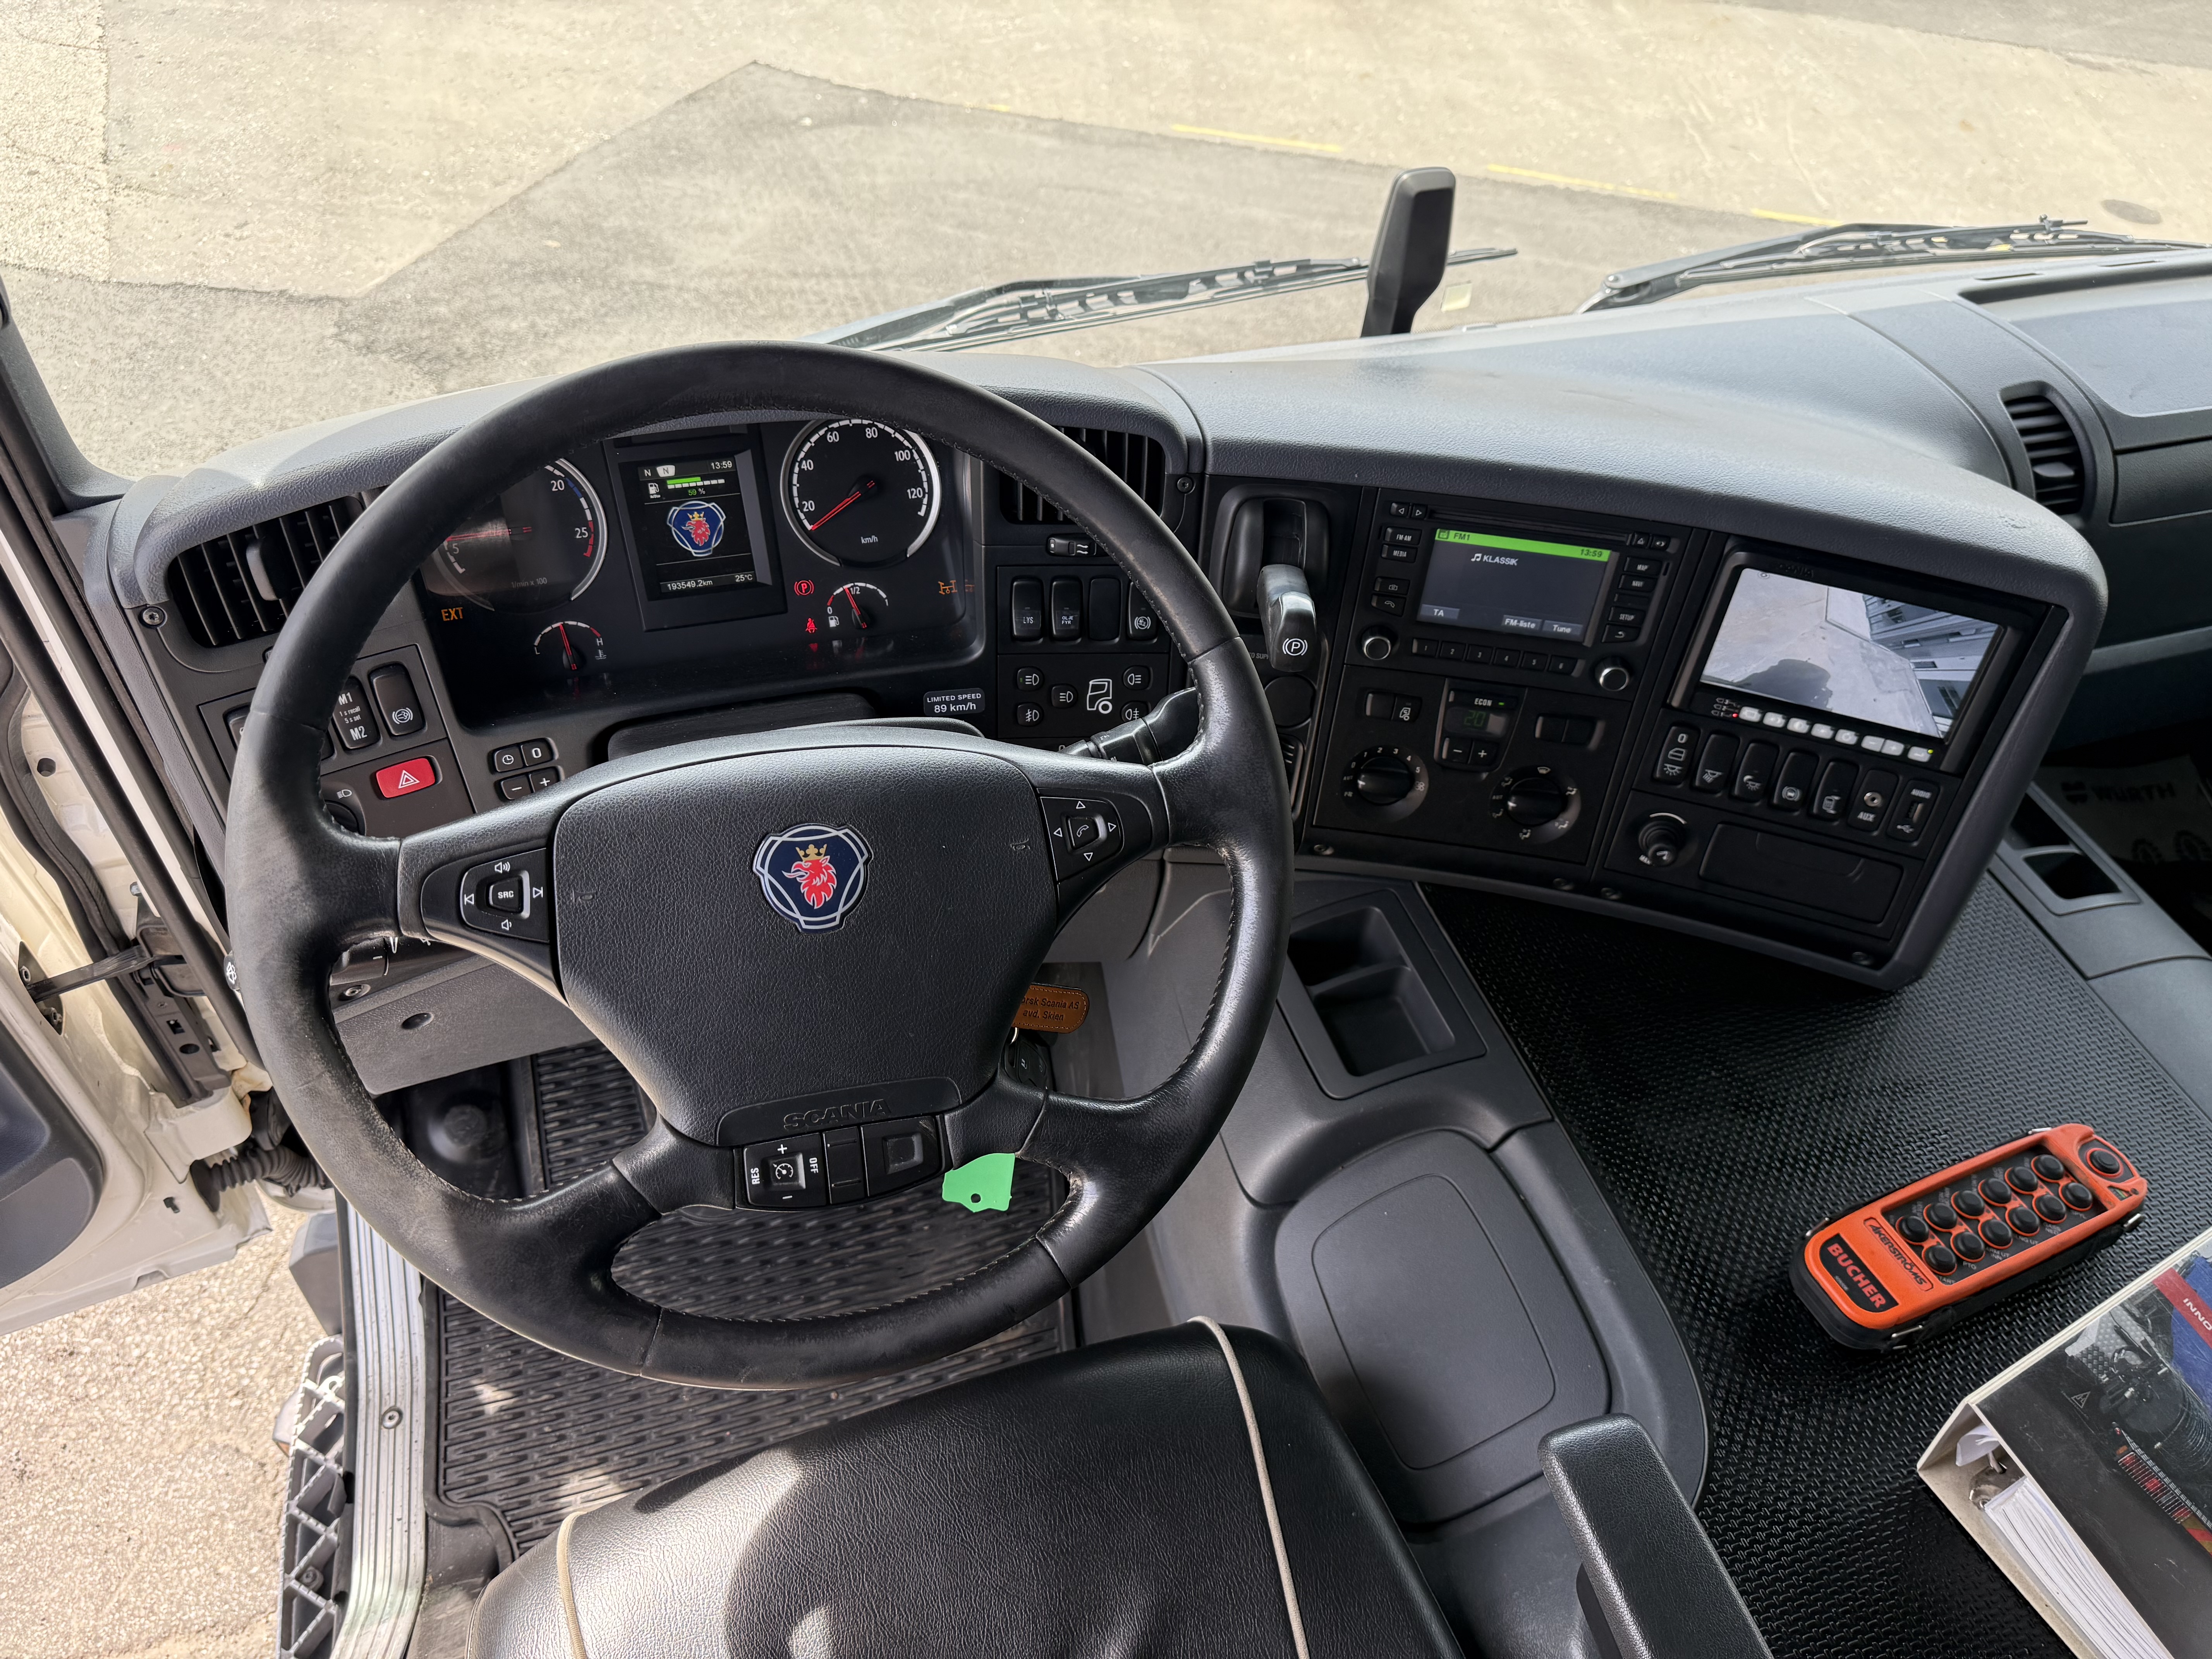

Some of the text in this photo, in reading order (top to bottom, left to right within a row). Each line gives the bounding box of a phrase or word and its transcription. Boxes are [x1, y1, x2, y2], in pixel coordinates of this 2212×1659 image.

[827, 431, 839, 442] 60
[866, 428, 878, 438] 80
[894, 450, 910, 461] 100
[711, 460, 732, 470] 13:59
[801, 460, 814, 471] 40
[551, 480, 565, 491] 20
[907, 488, 923, 499] 120
[802, 501, 815, 512] 20
[575, 527, 588, 538] 25
[1453, 532, 1470, 541] FM1
[861, 535, 878, 544] km/h
[452, 543, 459, 554] 5
[1580, 548, 1602, 558] 13:59
[1483, 555, 1518, 567] KLASSIK
[511, 580, 529, 589] 1/min
[536, 577, 547, 586] 100
[667, 574, 753, 591] 193549.2km 25°C
[441, 607, 463, 621] EXT
[1433, 609, 1444, 618] TA
[1023, 616, 1034, 624] LYS
[1504, 618, 1571, 634] FM-liste Tune
[596, 638, 603, 646] H
[338, 692, 353, 705] M1
[1474, 698, 1492, 707] ECON
[934, 702, 976, 713] 89 km/h
[1464, 710, 1486, 727] 20
[350, 726, 368, 740] M2
[532, 748, 542, 758] 0
[1910, 788, 1932, 799] AUDIO
[1857, 811, 1876, 822] AUX
[498, 890, 514, 898] SRC
[1041, 998, 1067, 1009] Scania
[1068, 1001, 1080, 1010] AS
[1023, 1009, 1064, 1021] avd. Skien
[783, 1099, 891, 1131] SCANIA
[809, 1157, 818, 1174] OFF
[751, 1167, 760, 1185] RES
[1827, 1242, 1887, 1309] BUCHER
